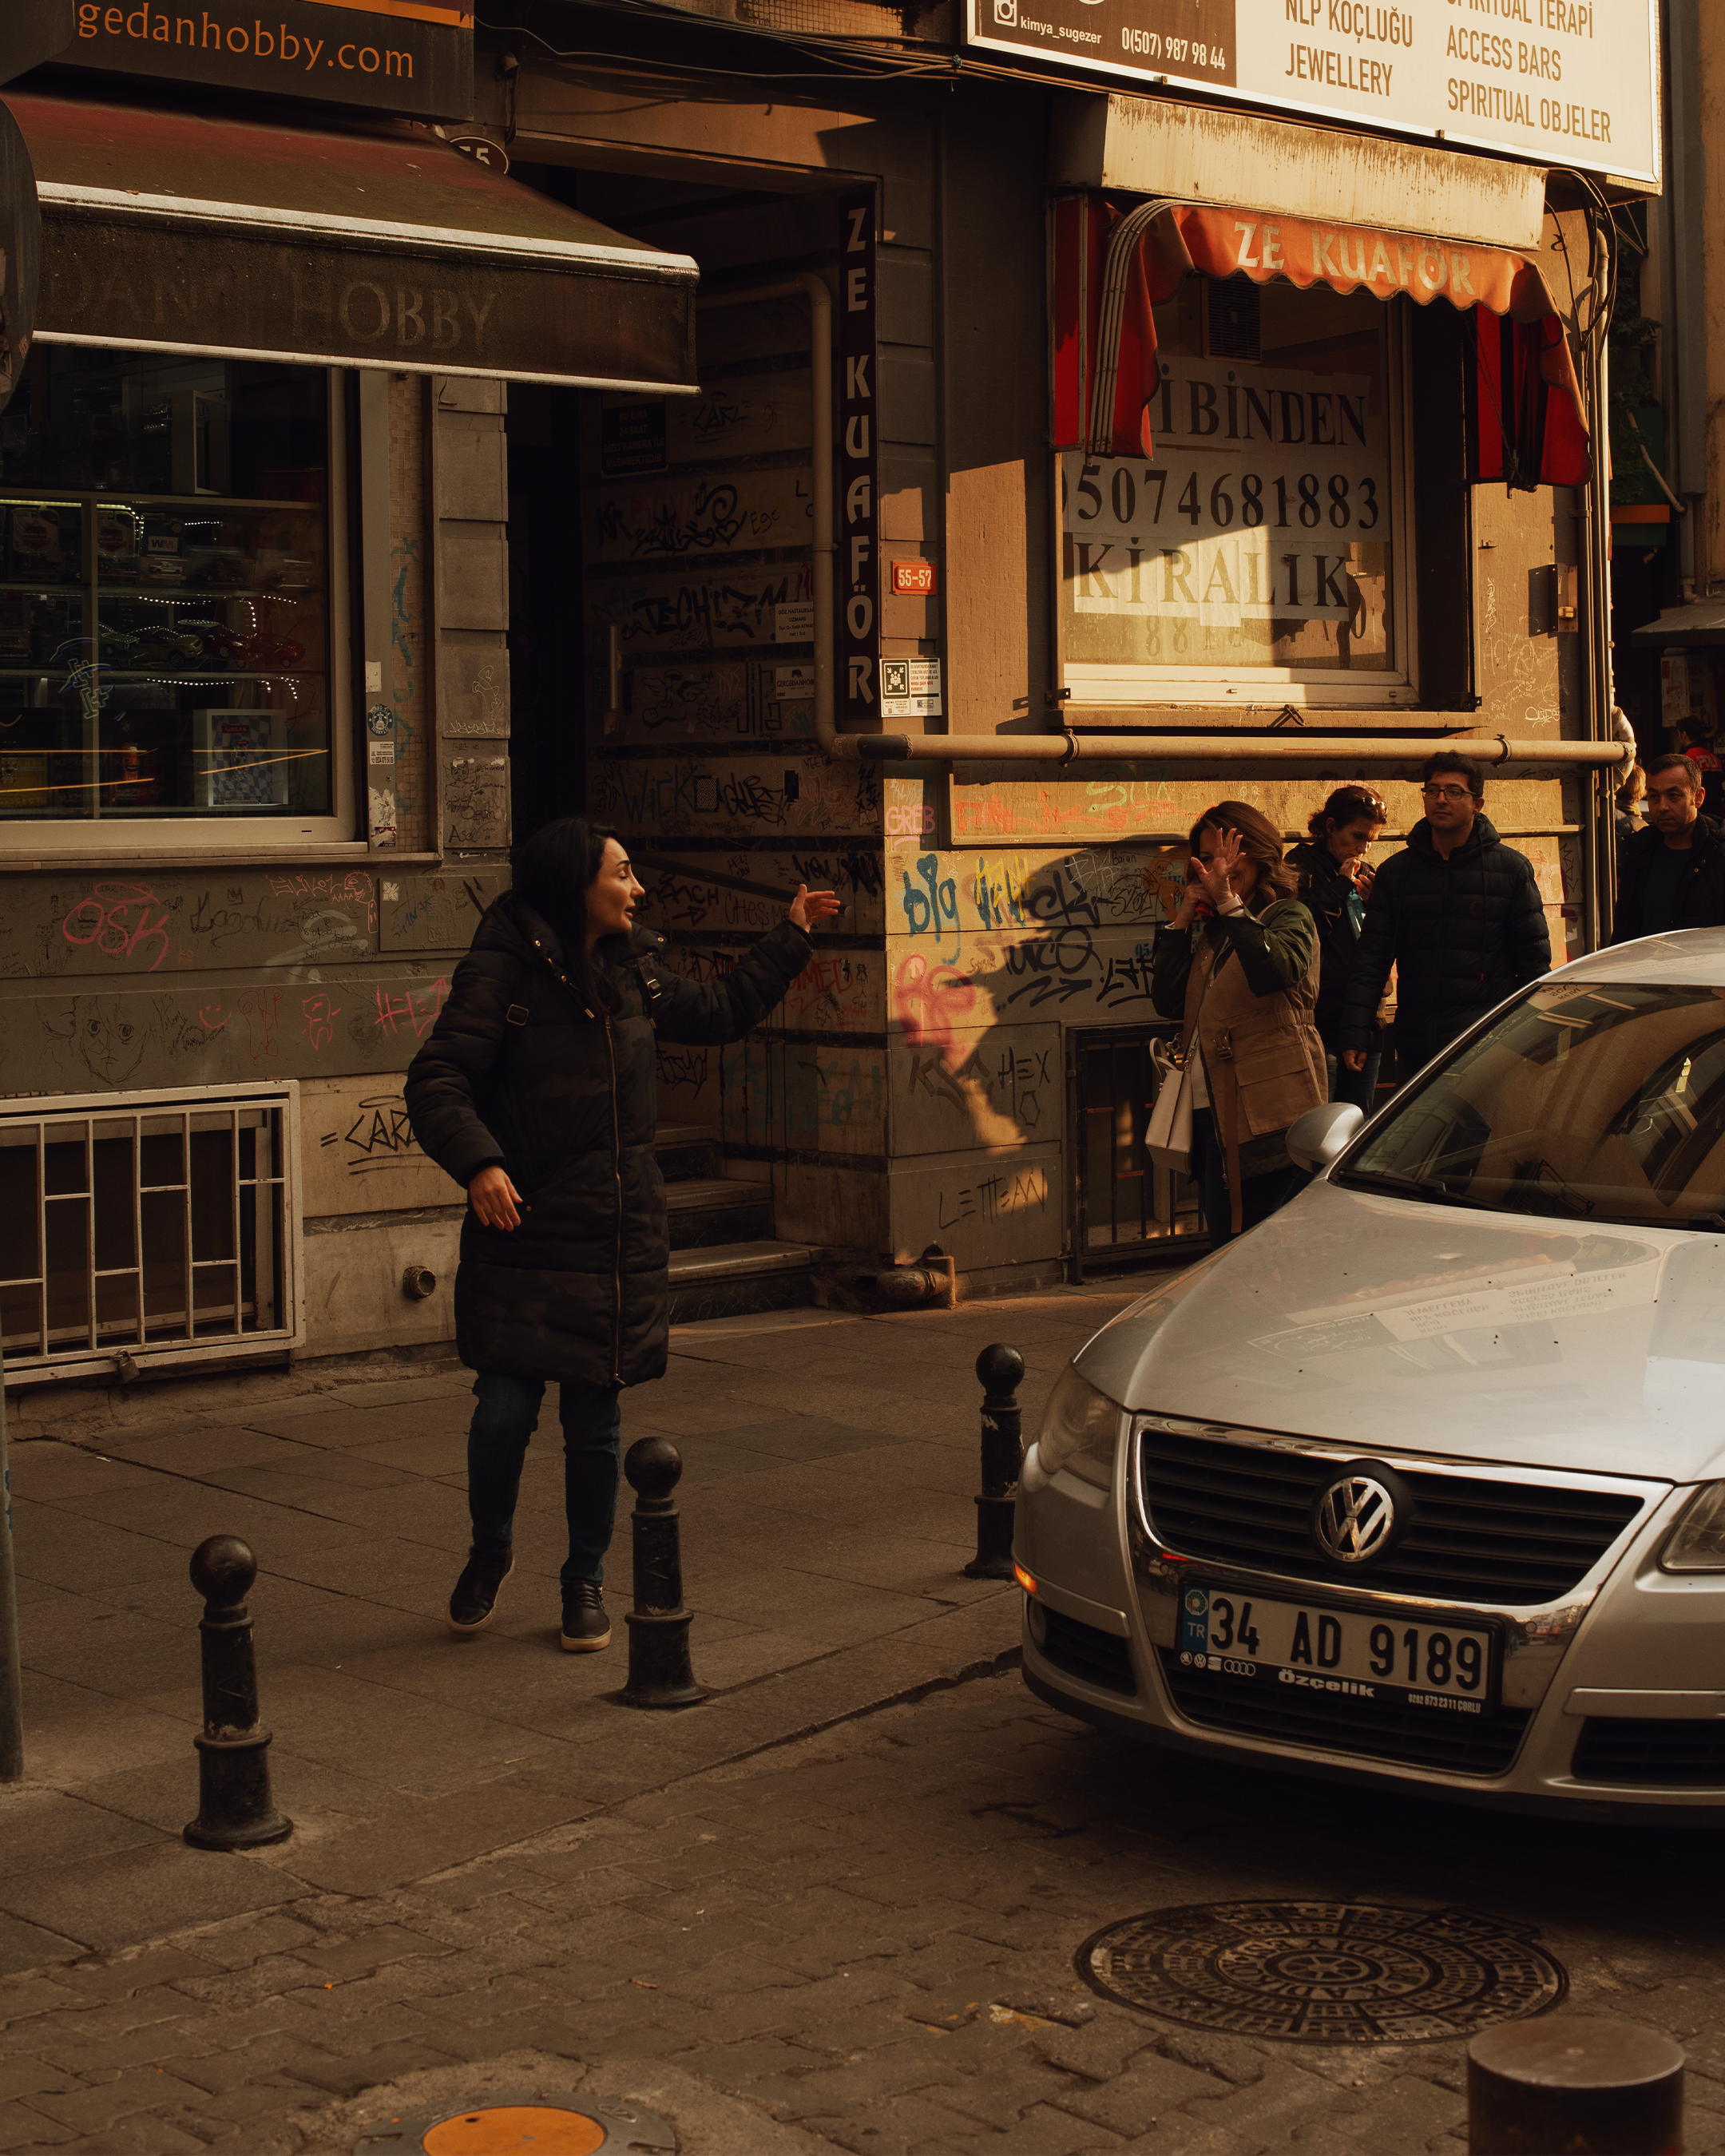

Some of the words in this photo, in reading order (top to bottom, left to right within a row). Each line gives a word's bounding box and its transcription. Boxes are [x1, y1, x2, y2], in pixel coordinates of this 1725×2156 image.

[1020, 16, 1102, 45] kimya_sugezer
[1285, 0, 1321, 26] NLP
[1328, 0, 1413, 48] KOÇLUĞU
[1539, 0, 1593, 39] TERAPİ
[1121, 26, 1162, 60] 0(507)
[1165, 36, 1188, 62] 987
[1192, 42, 1208, 67] 98
[1210, 47, 1226, 71] 44
[1285, 42, 1394, 97] JEWELLERY
[1446, 25, 1513, 70] ACCESS
[1518, 41, 1562, 81] BARS
[1447, 77, 1535, 127] SPIRITUAL
[1540, 98, 1612, 144] OBJELER
[1233, 220, 1285, 270] ZE
[1311, 228, 1476, 295] KUAFÖR
[619, 411, 629, 422] BU
[630, 408, 648, 420] BİNA
[1149, 363, 1366, 448] İBİNDEN
[619, 426, 629, 437] 24
[629, 424, 648, 435] SAAT
[622, 439, 652, 452] KAMERA
[1061, 464, 1378, 529] 5074681883
[898, 569, 932, 588] 55-57
[1073, 537, 1350, 609] KİRALIK
[1187, 1621, 1206, 1639] TR
[1210, 1597, 1260, 1656] 34
[1290, 1610, 1342, 1669] AD
[1369, 1623, 1482, 1691] 9189
[1278, 1668, 1375, 1698] Özçelik
[1457, 1699, 1481, 1714] ÇORLU
